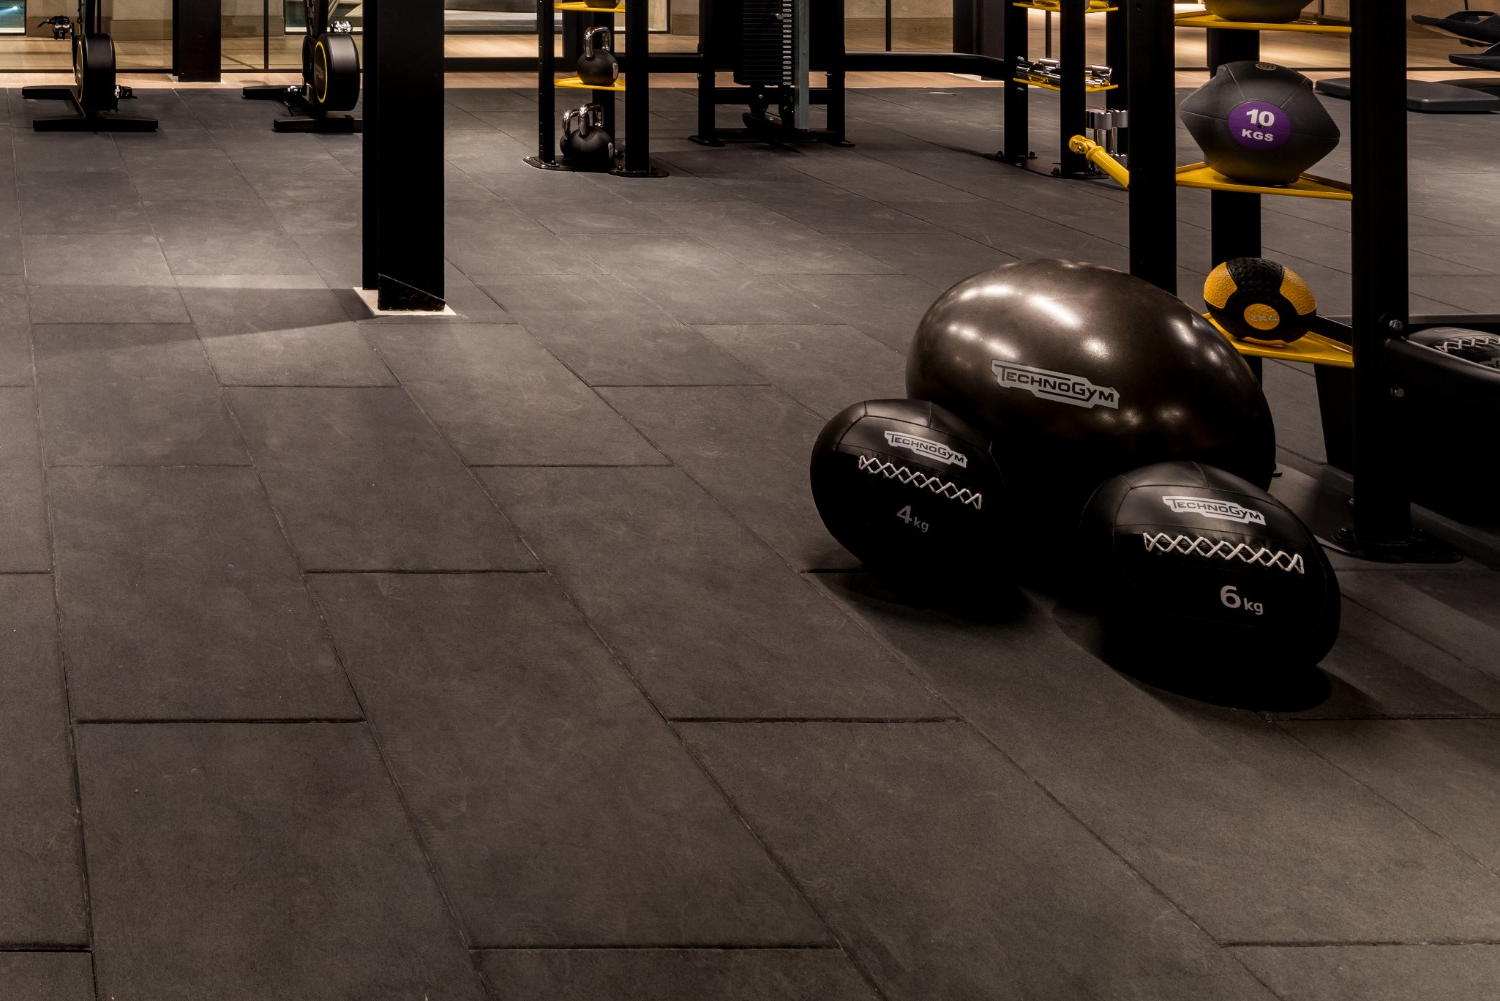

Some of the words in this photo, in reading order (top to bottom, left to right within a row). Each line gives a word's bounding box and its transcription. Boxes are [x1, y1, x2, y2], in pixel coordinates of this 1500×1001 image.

[1246, 108, 1275, 127] 10
[1241, 128, 1274, 142] KGS
[994, 363, 1114, 403] TECHNOGYM
[886, 432, 965, 464] TECHNOGYM
[1164, 497, 1262, 521] TECHNOGYM
